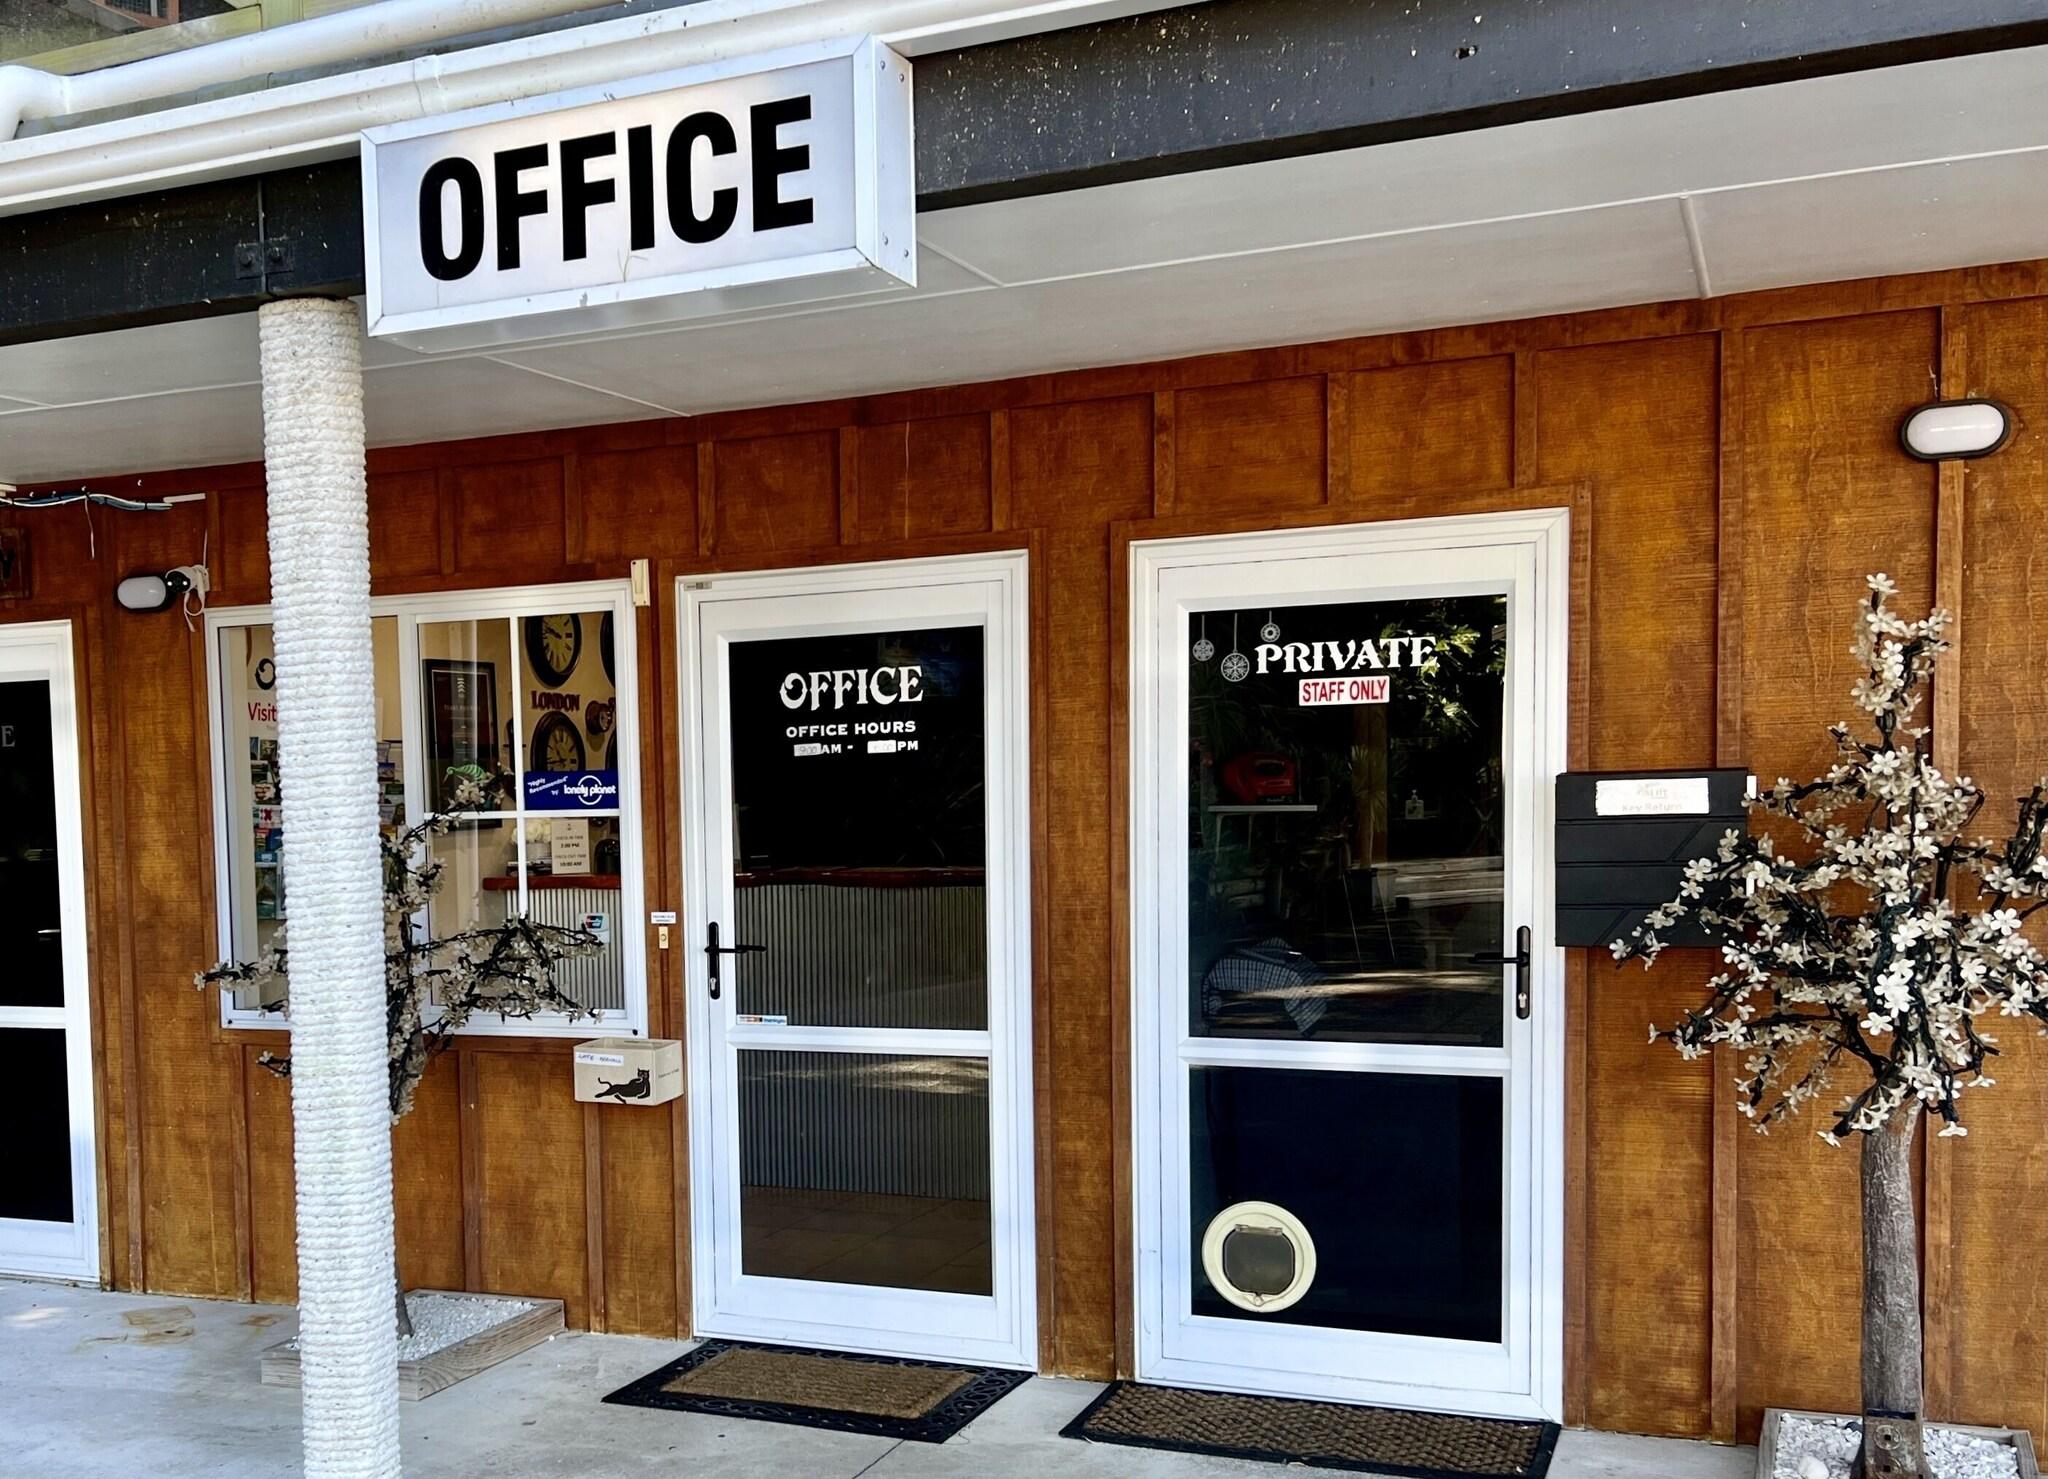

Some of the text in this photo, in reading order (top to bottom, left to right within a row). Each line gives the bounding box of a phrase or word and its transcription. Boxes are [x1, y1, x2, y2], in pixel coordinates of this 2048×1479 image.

[419, 95, 814, 282] OFFICE
[1254, 636, 1437, 674] PRIVATE
[779, 665, 924, 711] OFFICE
[1302, 679, 1387, 702] STAFF ONLY
[531, 690, 581, 711] LONDON
[786, 720, 917, 738] OFFICE HOURS
[564, 784, 616, 797] lonely planet
